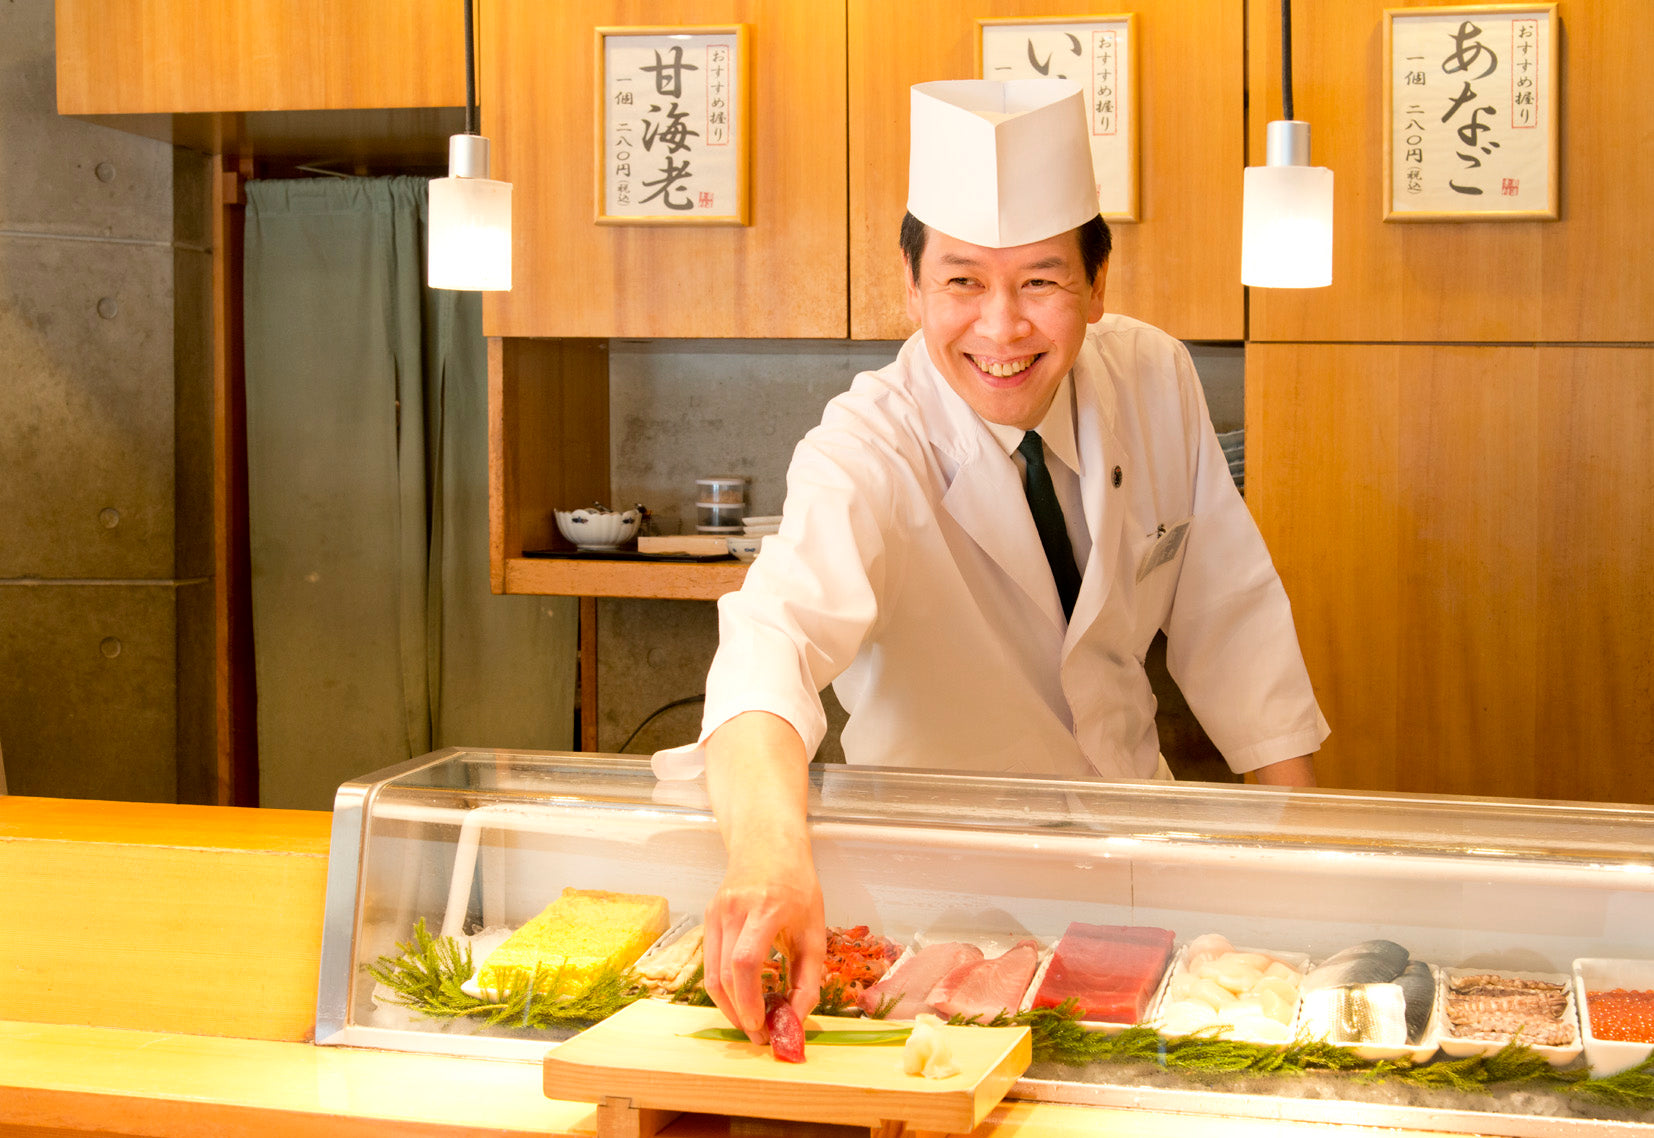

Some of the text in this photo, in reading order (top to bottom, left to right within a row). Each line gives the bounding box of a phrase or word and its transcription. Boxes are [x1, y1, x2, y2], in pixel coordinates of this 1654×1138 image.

[615, 77, 633, 106] 一個
[709, 50, 727, 142] おすすめ握り
[1028, 32, 1083, 79] い
[1096, 36, 1114, 132] おすすめ握り
[1404, 56, 1426, 86] 一個
[1515, 24, 1535, 124] おすすめ握り
[638, 45, 700, 211] 甘海老
[1441, 20, 1501, 196] あなご
